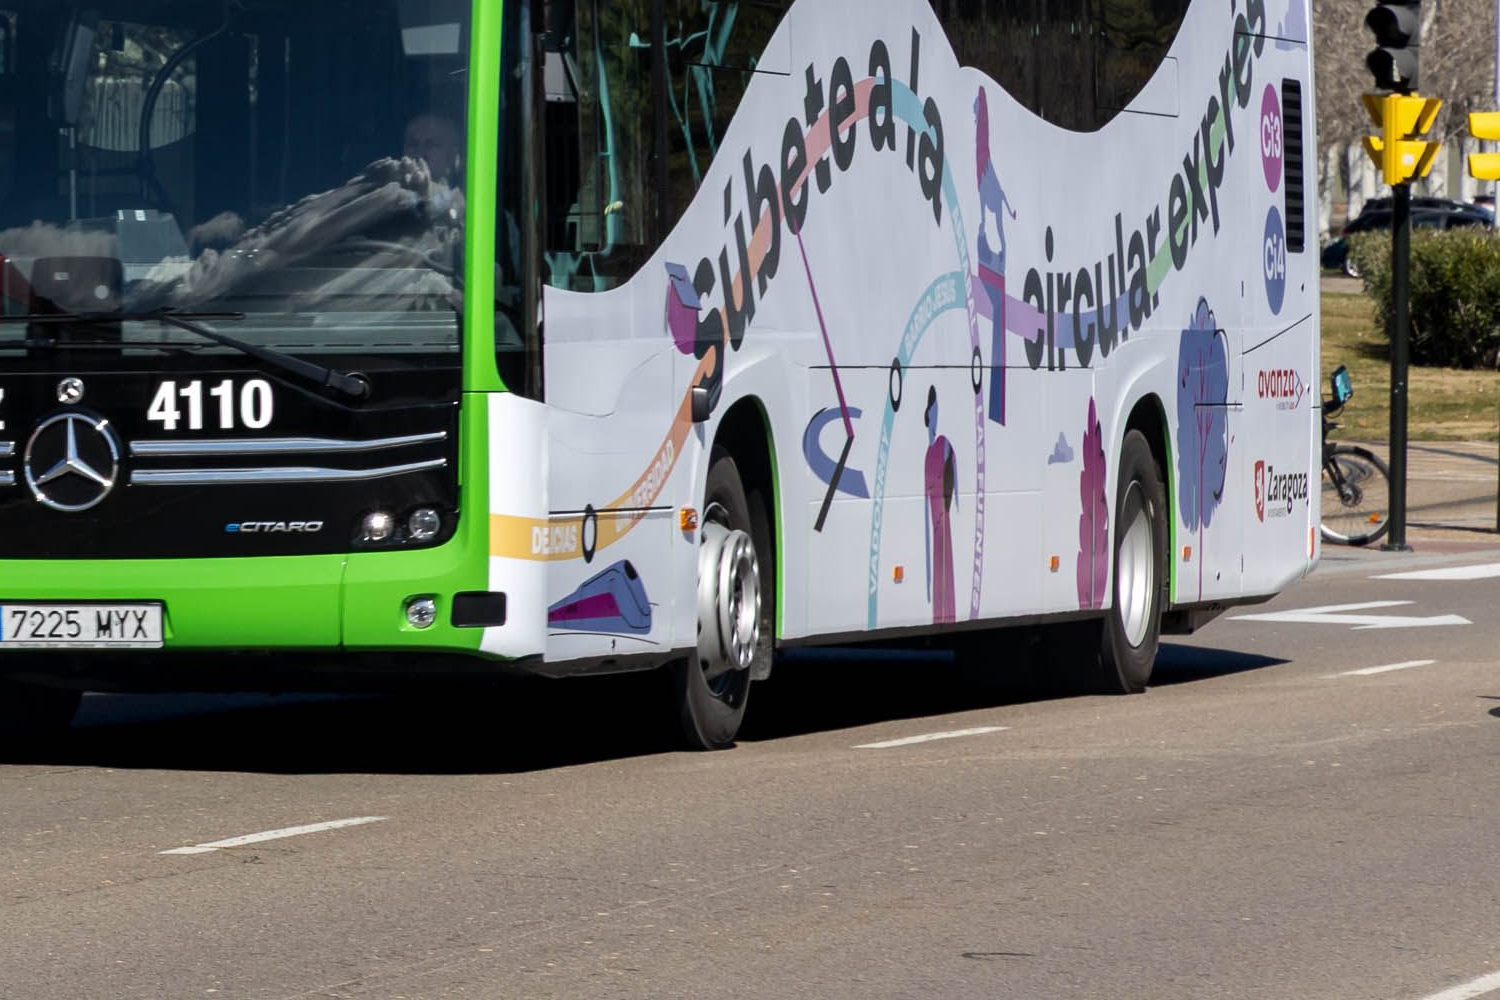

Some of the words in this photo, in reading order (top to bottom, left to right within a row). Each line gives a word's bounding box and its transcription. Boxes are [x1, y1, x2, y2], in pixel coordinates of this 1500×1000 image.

[869, 38, 897, 153] a
[906, 25, 945, 228] la
[1261, 111, 1282, 159] Ci3
[1264, 233, 1285, 281] Ci4
[1022, 203, 1161, 372] circular
[146, 379, 274, 430] 4110
[1258, 369, 1295, 399] avanza
[1267, 465, 1308, 515] Zaragoza
[225, 521, 324, 532] eCITARO
[11, 610, 82, 639] 7225
[95, 610, 149, 639] MYX
